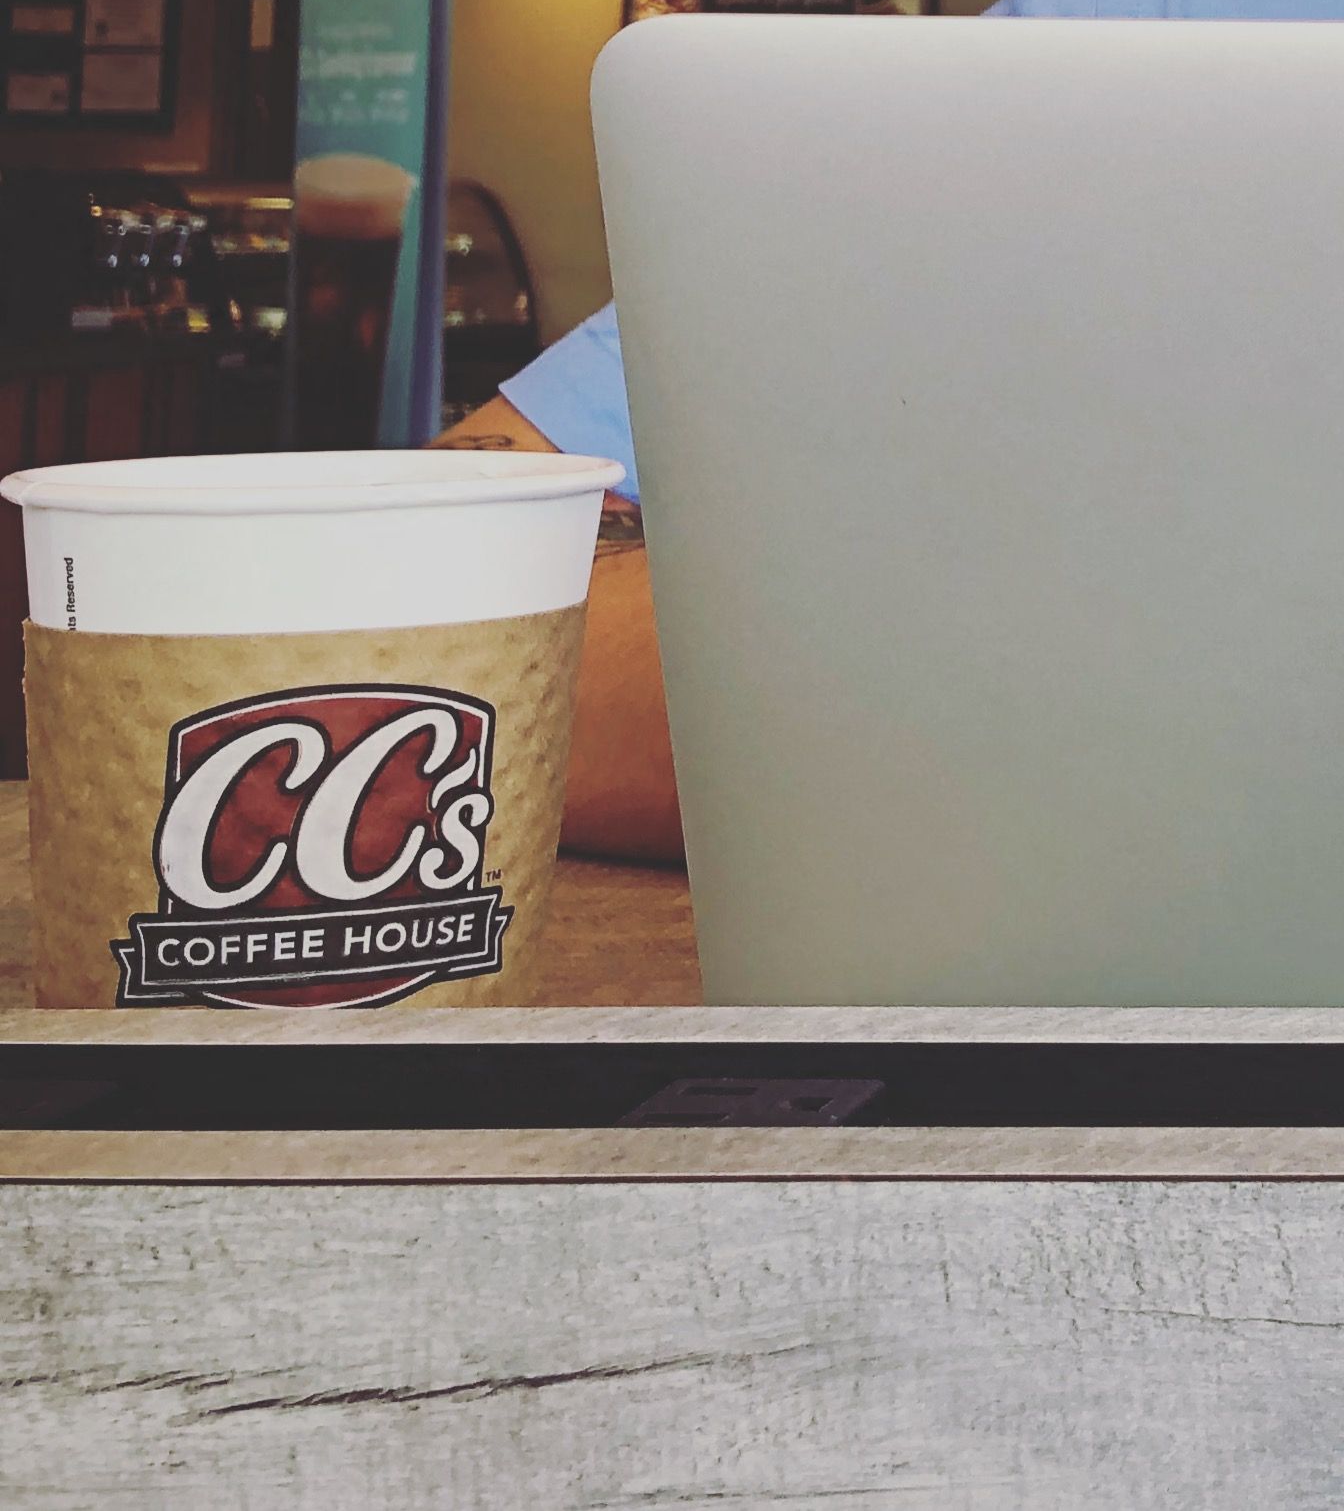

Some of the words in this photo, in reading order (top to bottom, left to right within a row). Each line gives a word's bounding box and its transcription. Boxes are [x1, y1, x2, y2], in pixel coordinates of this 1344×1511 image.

[63, 557, 76, 613] Reserved
[486, 869, 503, 883] TM
[157, 928, 325, 967] COFFEE
[343, 912, 476, 957] HOUSE
